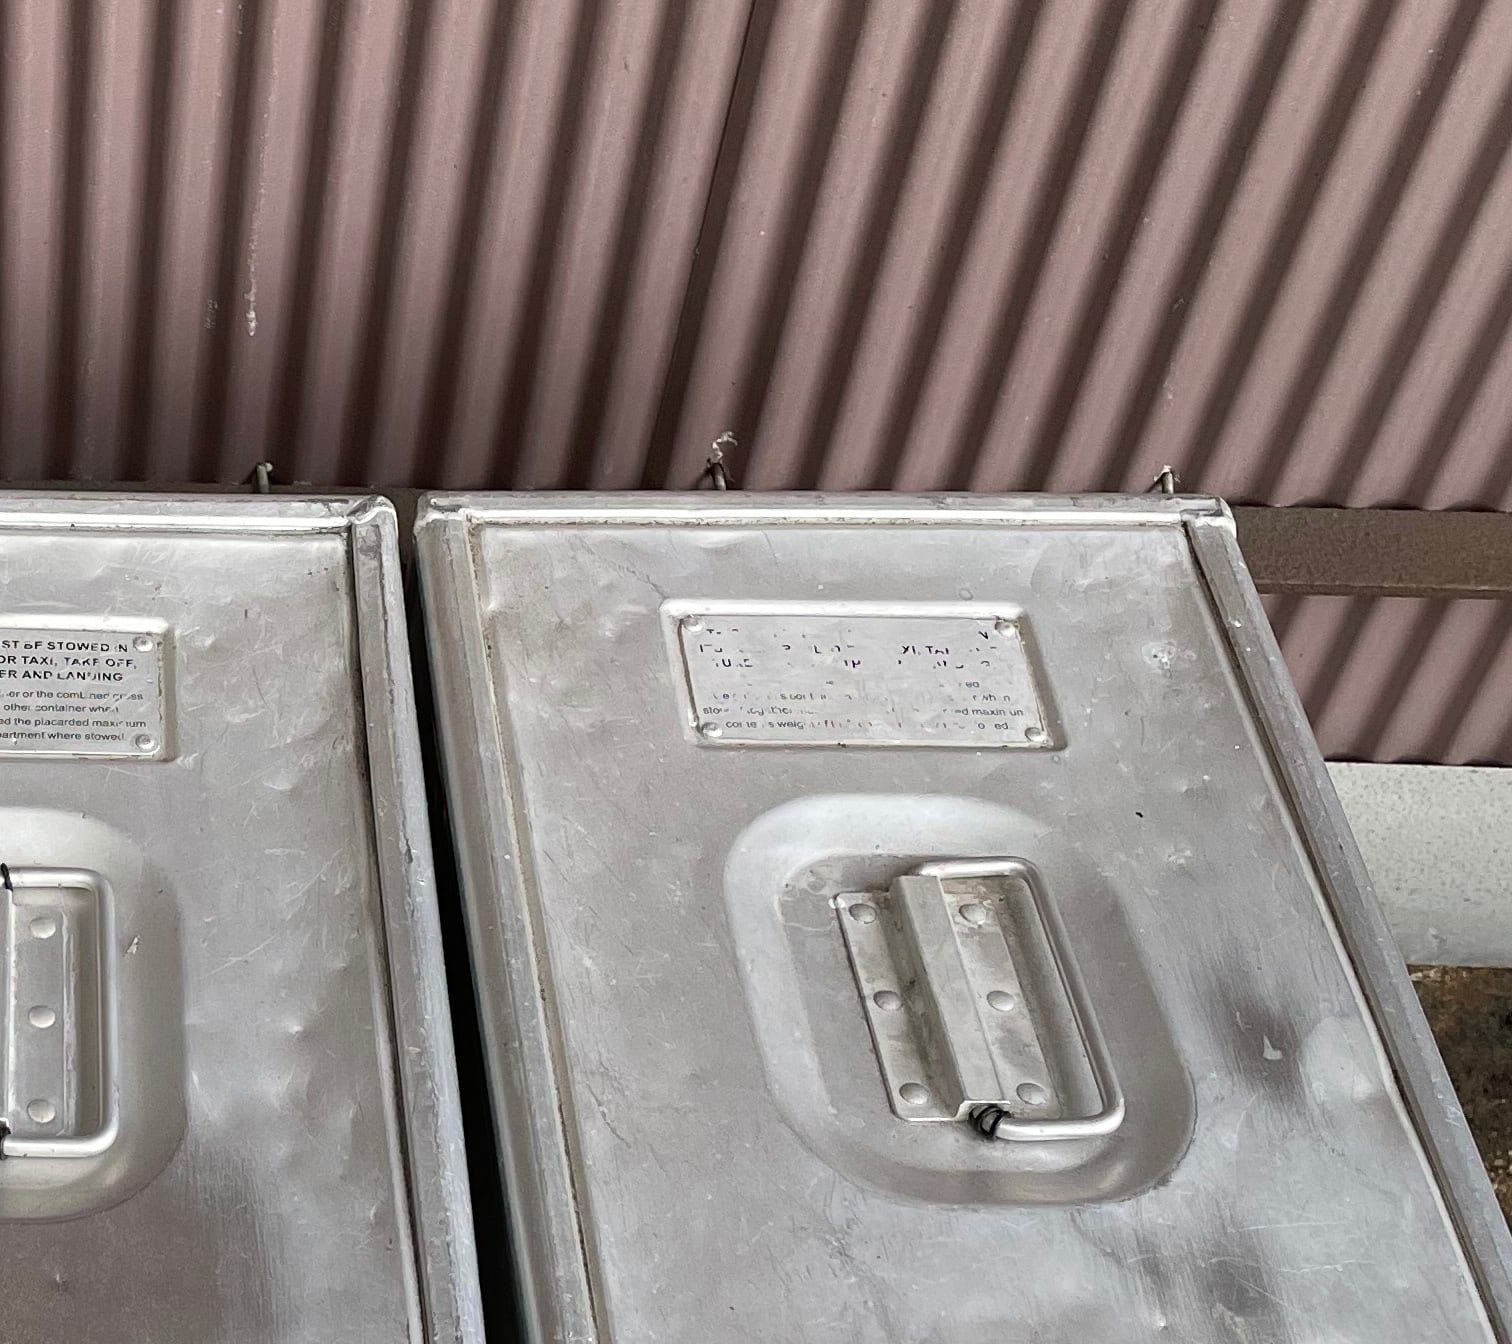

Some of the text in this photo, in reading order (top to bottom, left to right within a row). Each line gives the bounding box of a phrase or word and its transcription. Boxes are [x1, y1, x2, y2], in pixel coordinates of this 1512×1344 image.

[47, 641, 110, 652] STOWED
[22, 670, 53, 680] AND
[23, 690, 34, 698] or
[37, 689, 53, 699] the
[14, 717, 31, 726] the
[34, 718, 89, 727] placarded
[48, 731, 82, 740] where
